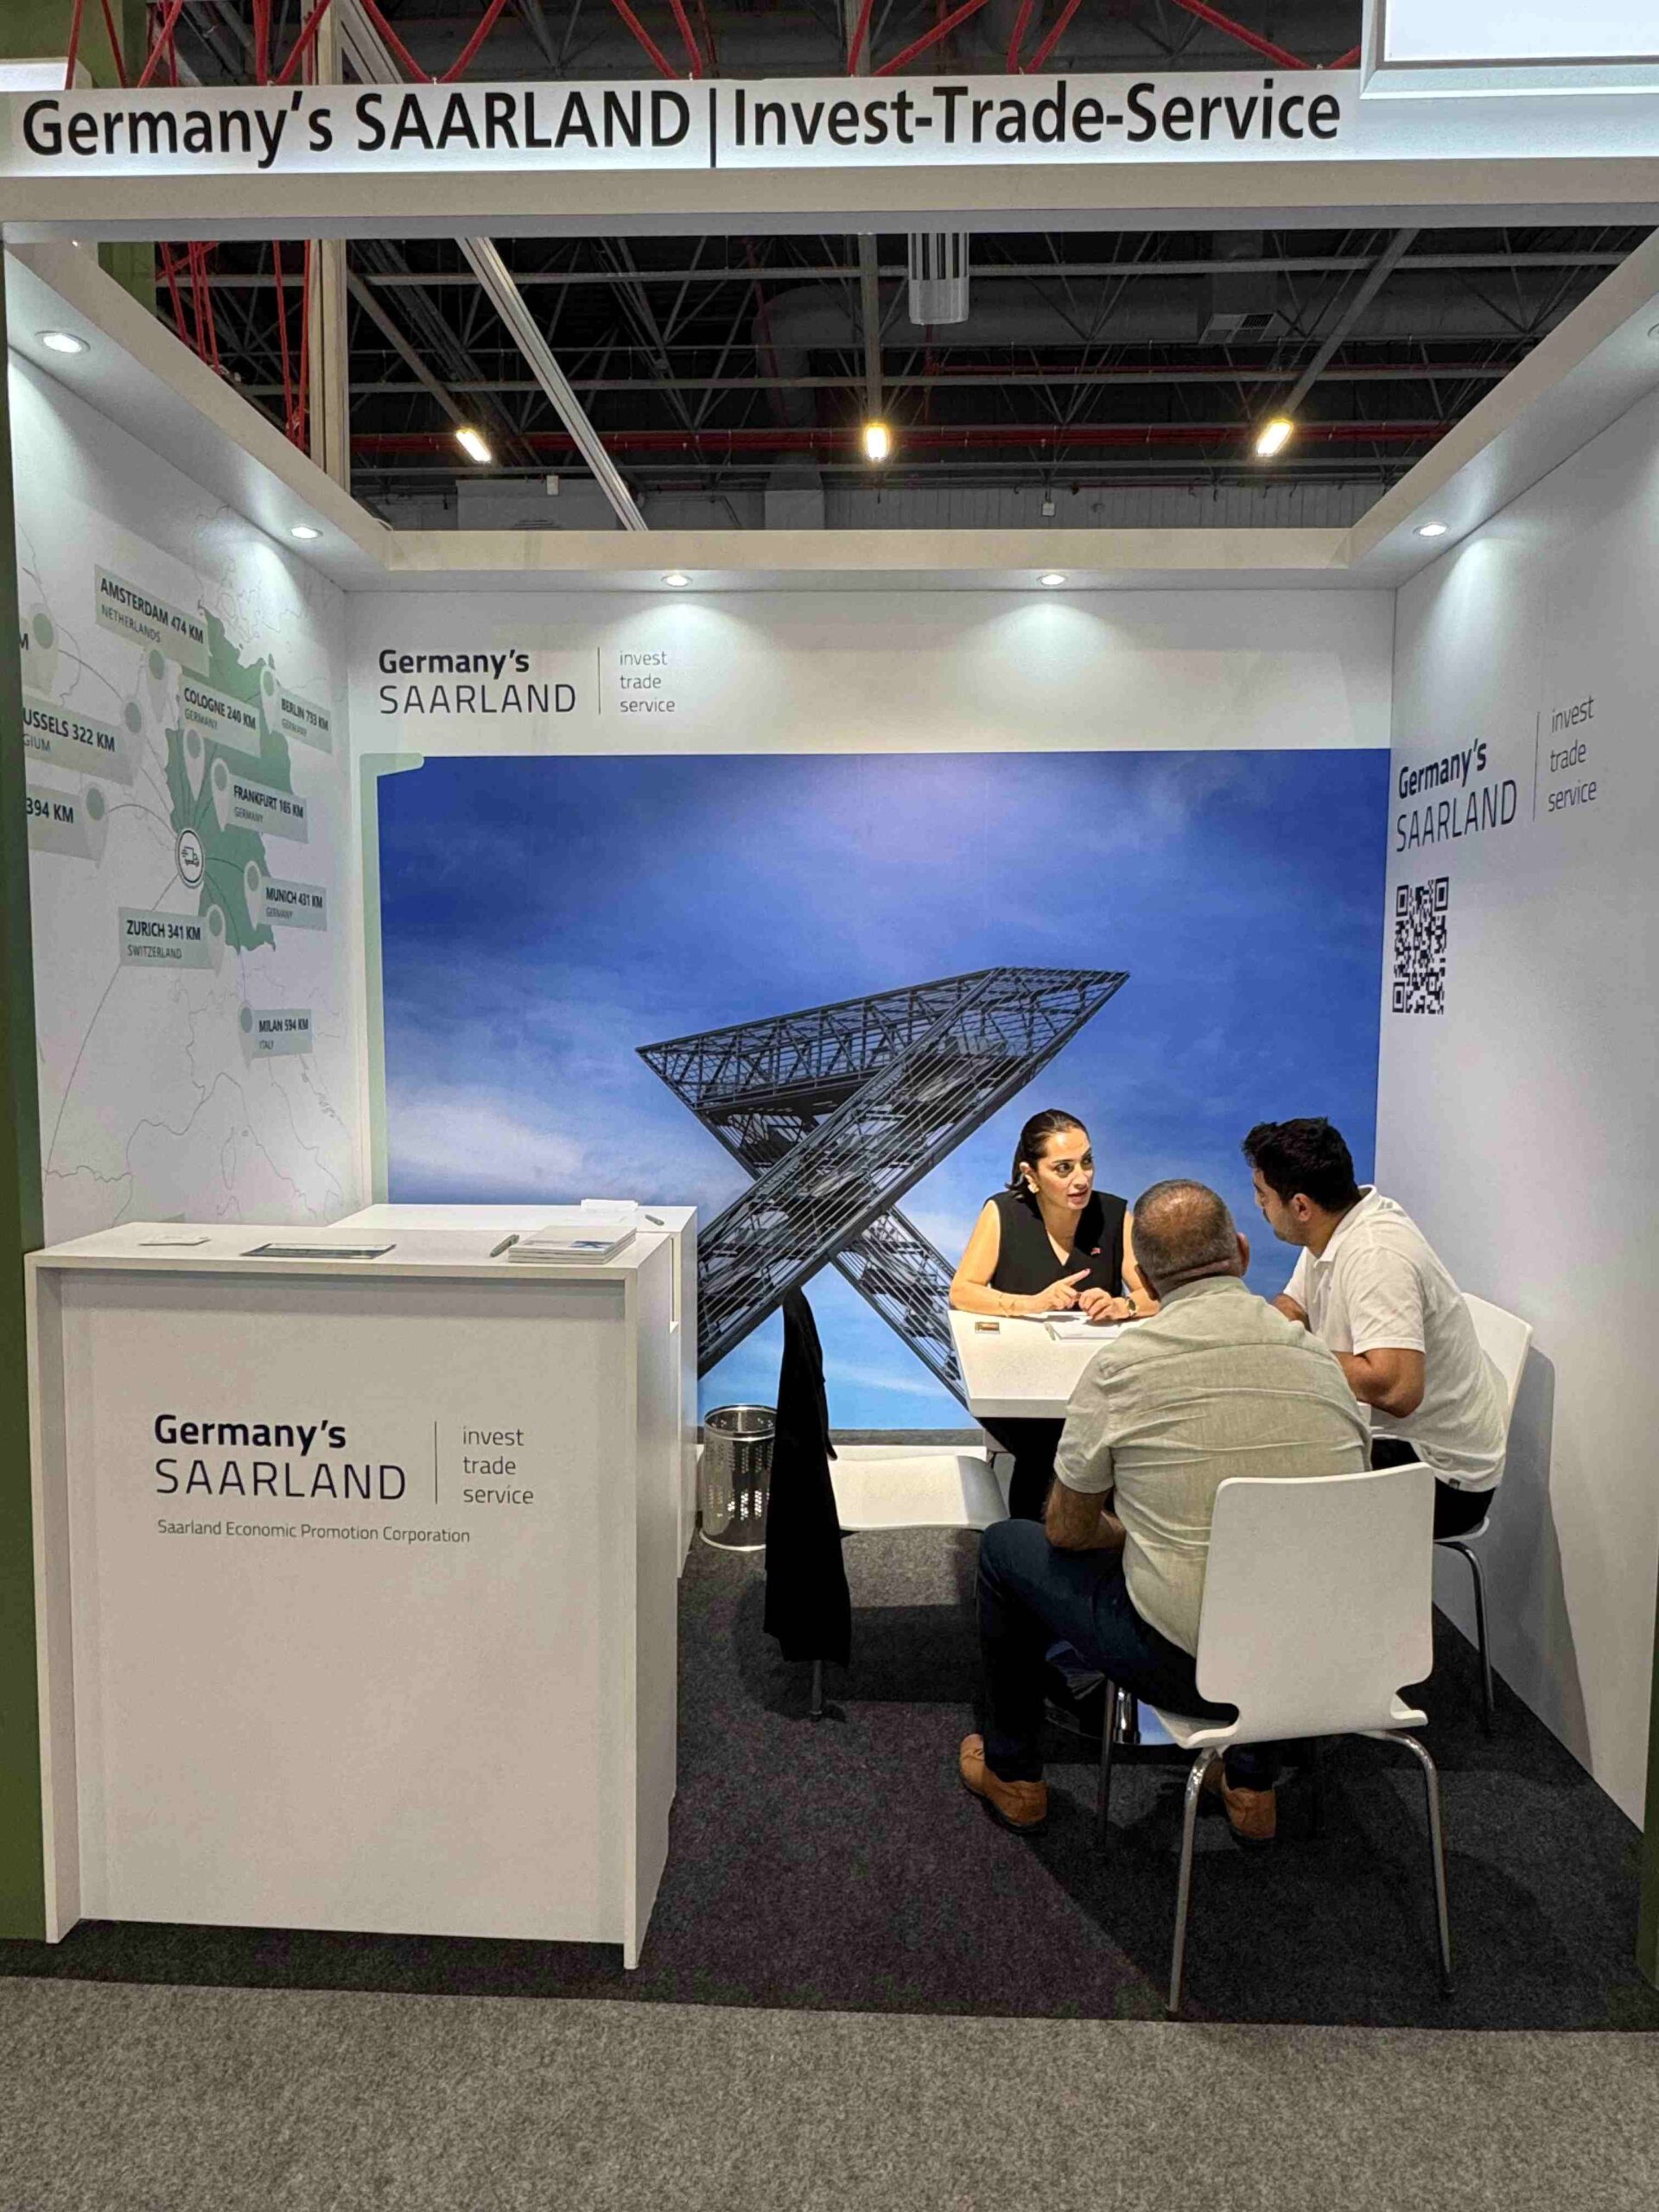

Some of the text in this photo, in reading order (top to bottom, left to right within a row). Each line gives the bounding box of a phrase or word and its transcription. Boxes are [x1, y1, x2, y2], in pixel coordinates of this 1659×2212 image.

[22, 78, 1340, 169] Germany's SAARLAND Invest-Trade-Service
[100, 577, 204, 645] AMSTERDAM 474 KM
[101, 604, 162, 644] NETHERLANDS
[378, 648, 531, 680] Germany's
[619, 650, 668, 666] invest
[619, 674, 662, 690] trade
[184, 687, 257, 730] COLOGNE 240 KM
[281, 698, 305, 721] BERLIN
[379, 683, 576, 715] SAARLAND
[619, 698, 676, 713] service
[1551, 695, 1596, 734] invest
[22, 707, 116, 753] USSELS 322 KM
[1397, 738, 1488, 800] Germany's
[1549, 740, 1587, 772] trade
[26, 798, 74, 823] 394 KM
[233, 785, 277, 810] FRANKFURT
[292, 804, 304, 819] KM
[1548, 780, 1598, 812] service
[1395, 779, 1518, 853] SAARLAND
[265, 887, 324, 909] MUNICH 431 KM
[126, 919, 201, 941] ZURICH 341 KM
[127, 944, 182, 960] SWITZERLAND
[258, 1019, 283, 1033] MILAN
[297, 1017, 309, 1031] KM
[154, 1414, 346, 1456] Germany's
[462, 1425, 524, 1446] invest
[155, 1458, 406, 1501] SAARLAND
[462, 1455, 517, 1476] trade
[462, 1484, 534, 1504] service
[157, 1518, 471, 1545] Saarland Economic Promotion Corporation
